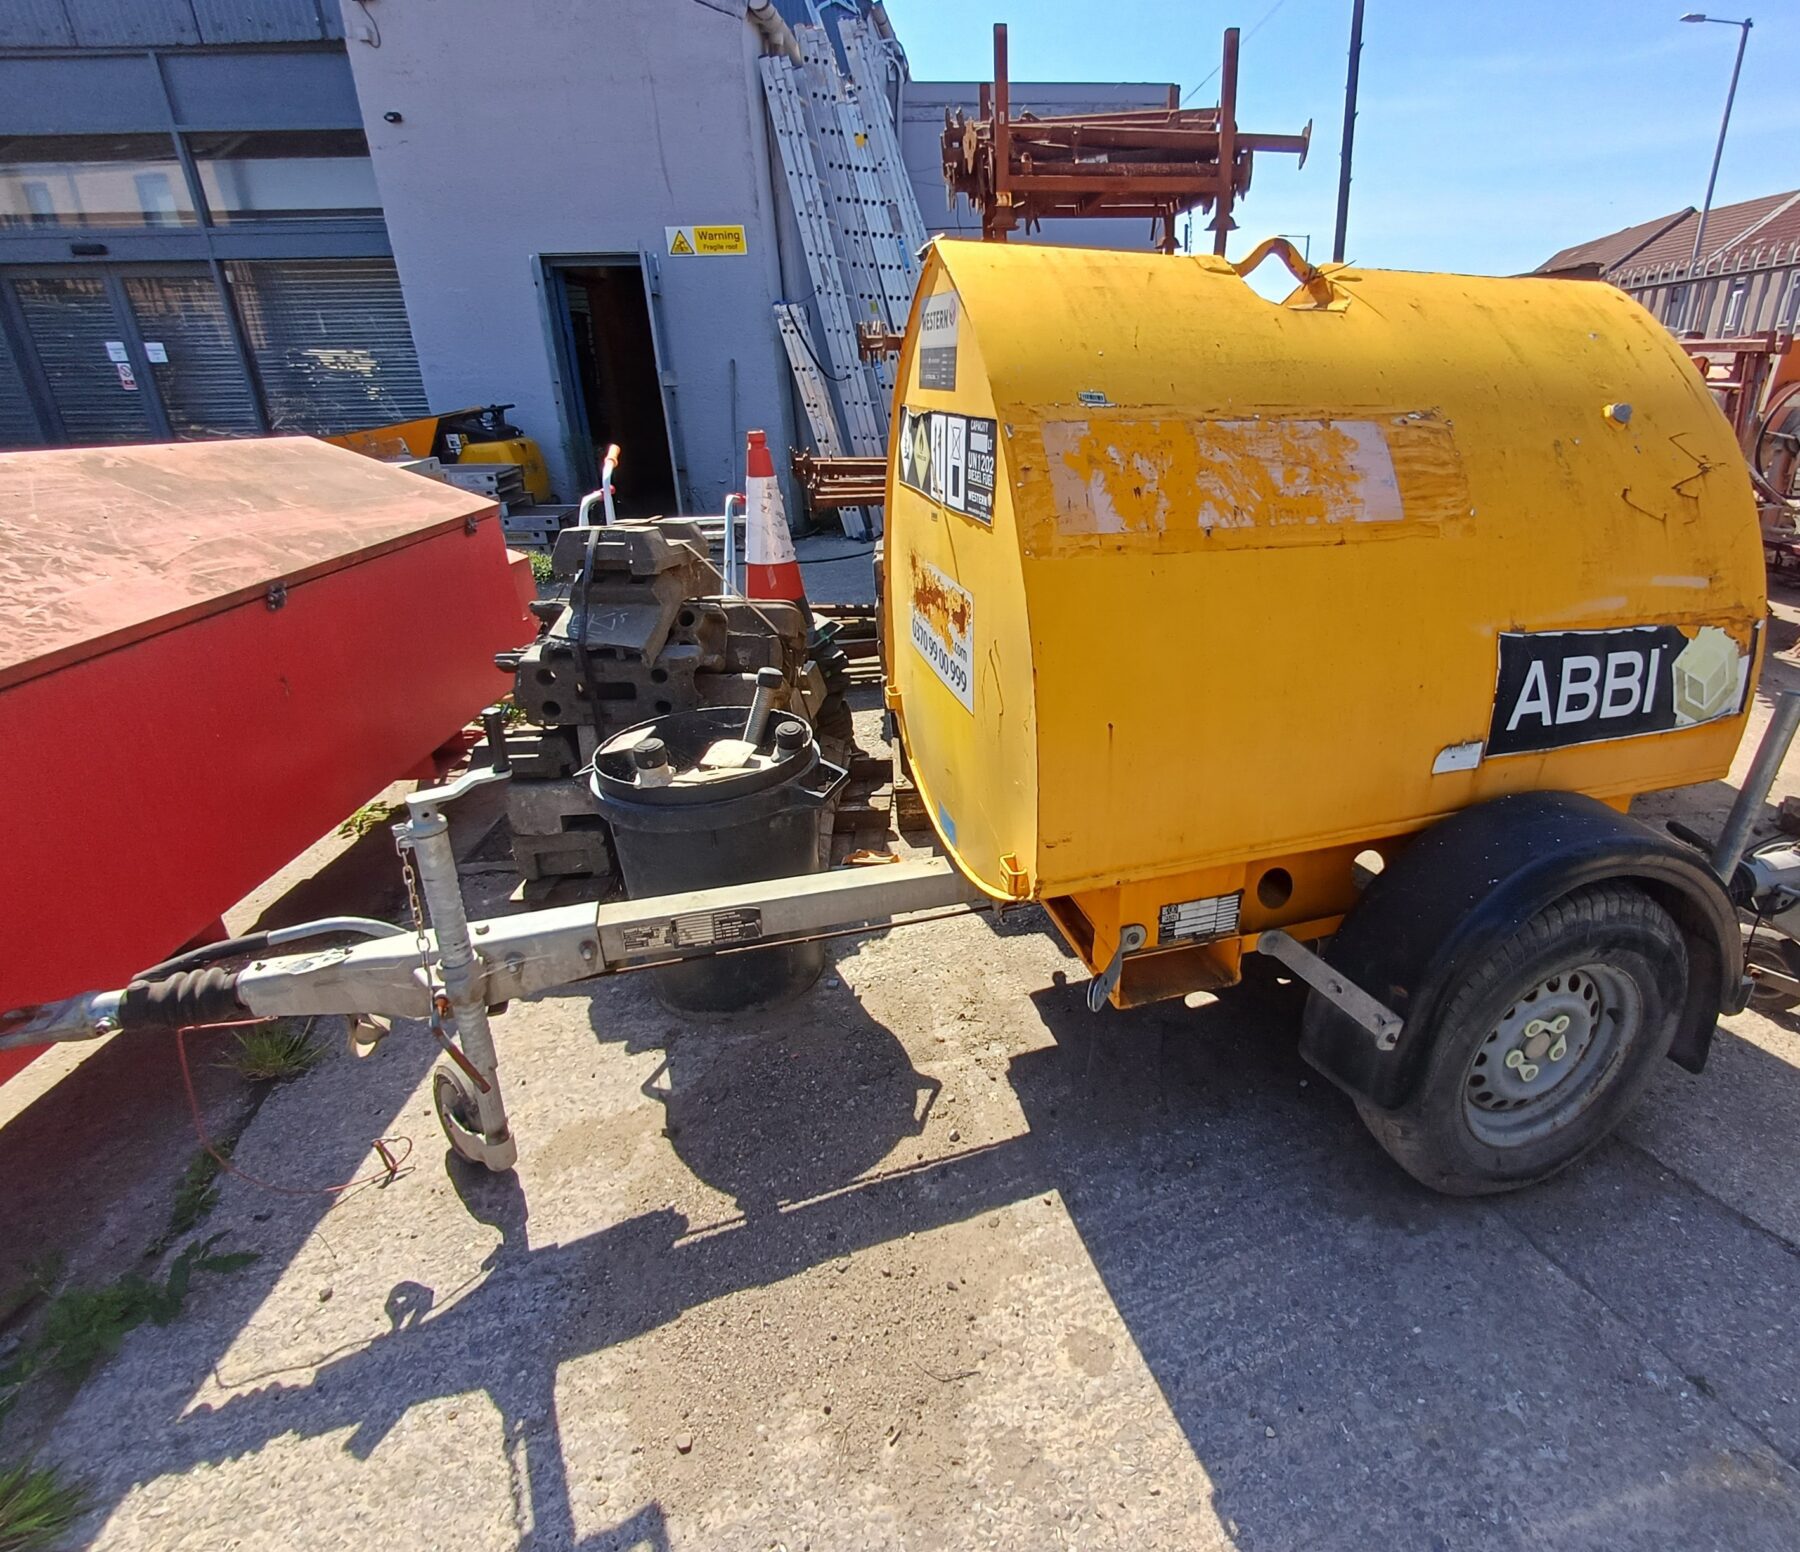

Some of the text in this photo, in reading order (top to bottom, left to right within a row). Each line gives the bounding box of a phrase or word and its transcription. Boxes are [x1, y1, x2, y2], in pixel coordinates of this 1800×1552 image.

[697, 230, 740, 242] Warning
[703, 243, 724, 252] Fragile
[921, 308, 949, 331] WESTERN
[970, 419, 988, 432] CAPACITY
[967, 469, 993, 488] DIESEL FUEL
[967, 490, 988, 507] WESTERN
[912, 616, 967, 693] 0370 99 00 999
[1505, 648, 1660, 732] ABBI
